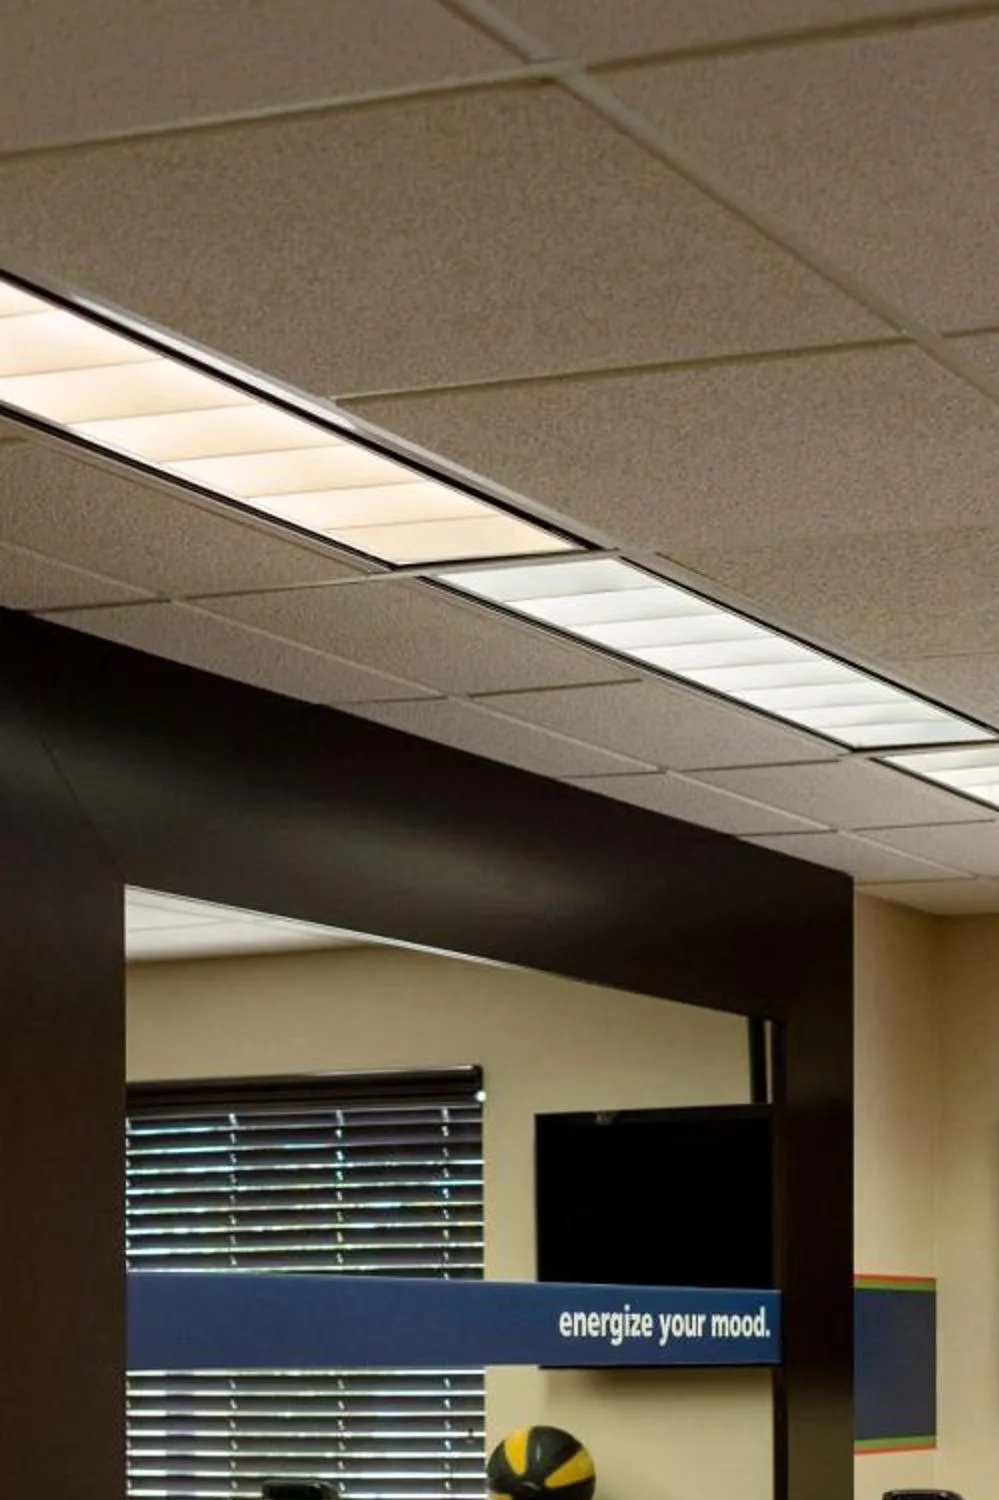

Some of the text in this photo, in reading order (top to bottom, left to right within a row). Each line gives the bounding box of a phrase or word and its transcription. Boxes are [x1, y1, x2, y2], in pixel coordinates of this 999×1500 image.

[559, 1304, 771, 1346] energize your mood.
